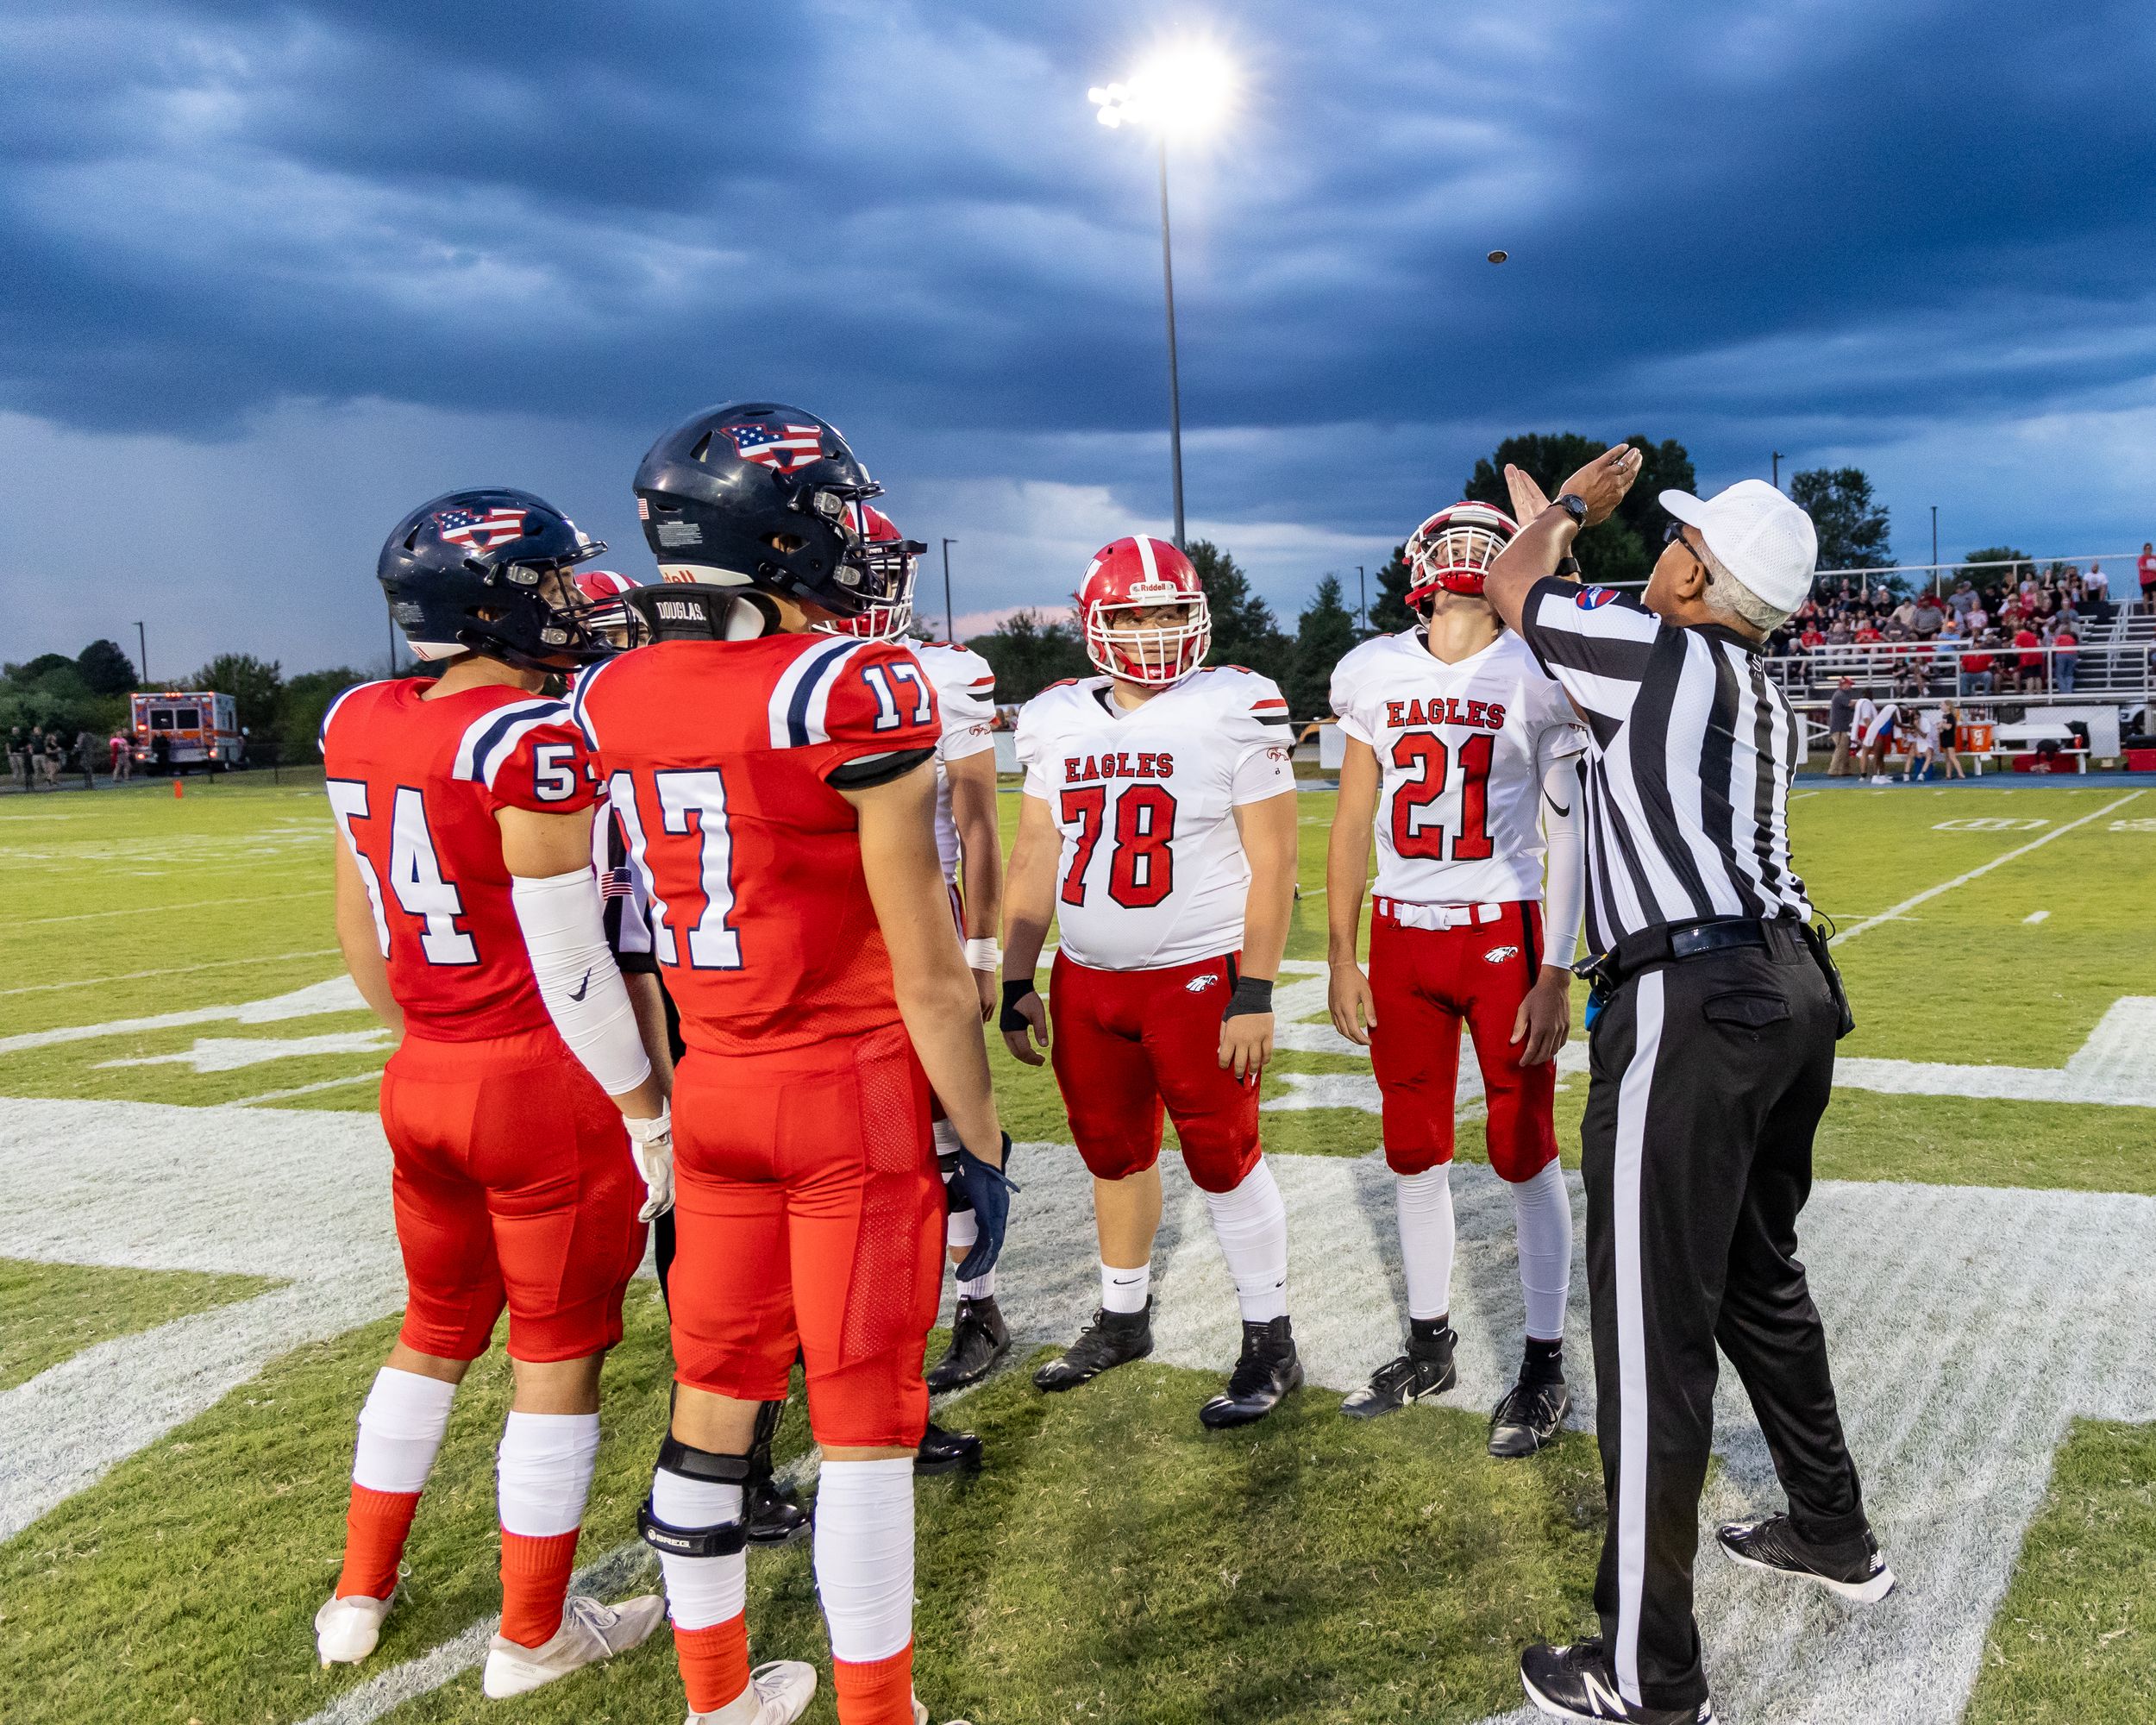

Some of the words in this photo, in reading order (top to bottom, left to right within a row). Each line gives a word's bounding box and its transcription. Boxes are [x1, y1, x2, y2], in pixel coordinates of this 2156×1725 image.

[1140, 583, 1166, 592] Riddell
[862, 662, 933, 732] 17
[1387, 698, 1506, 730] EAGLES
[533, 743, 606, 802] 5
[1064, 752, 1173, 783] EAGLES
[1390, 731, 1495, 862] 21
[326, 777, 481, 967] 54
[608, 768, 744, 970] 17
[1059, 783, 1178, 910] 78
